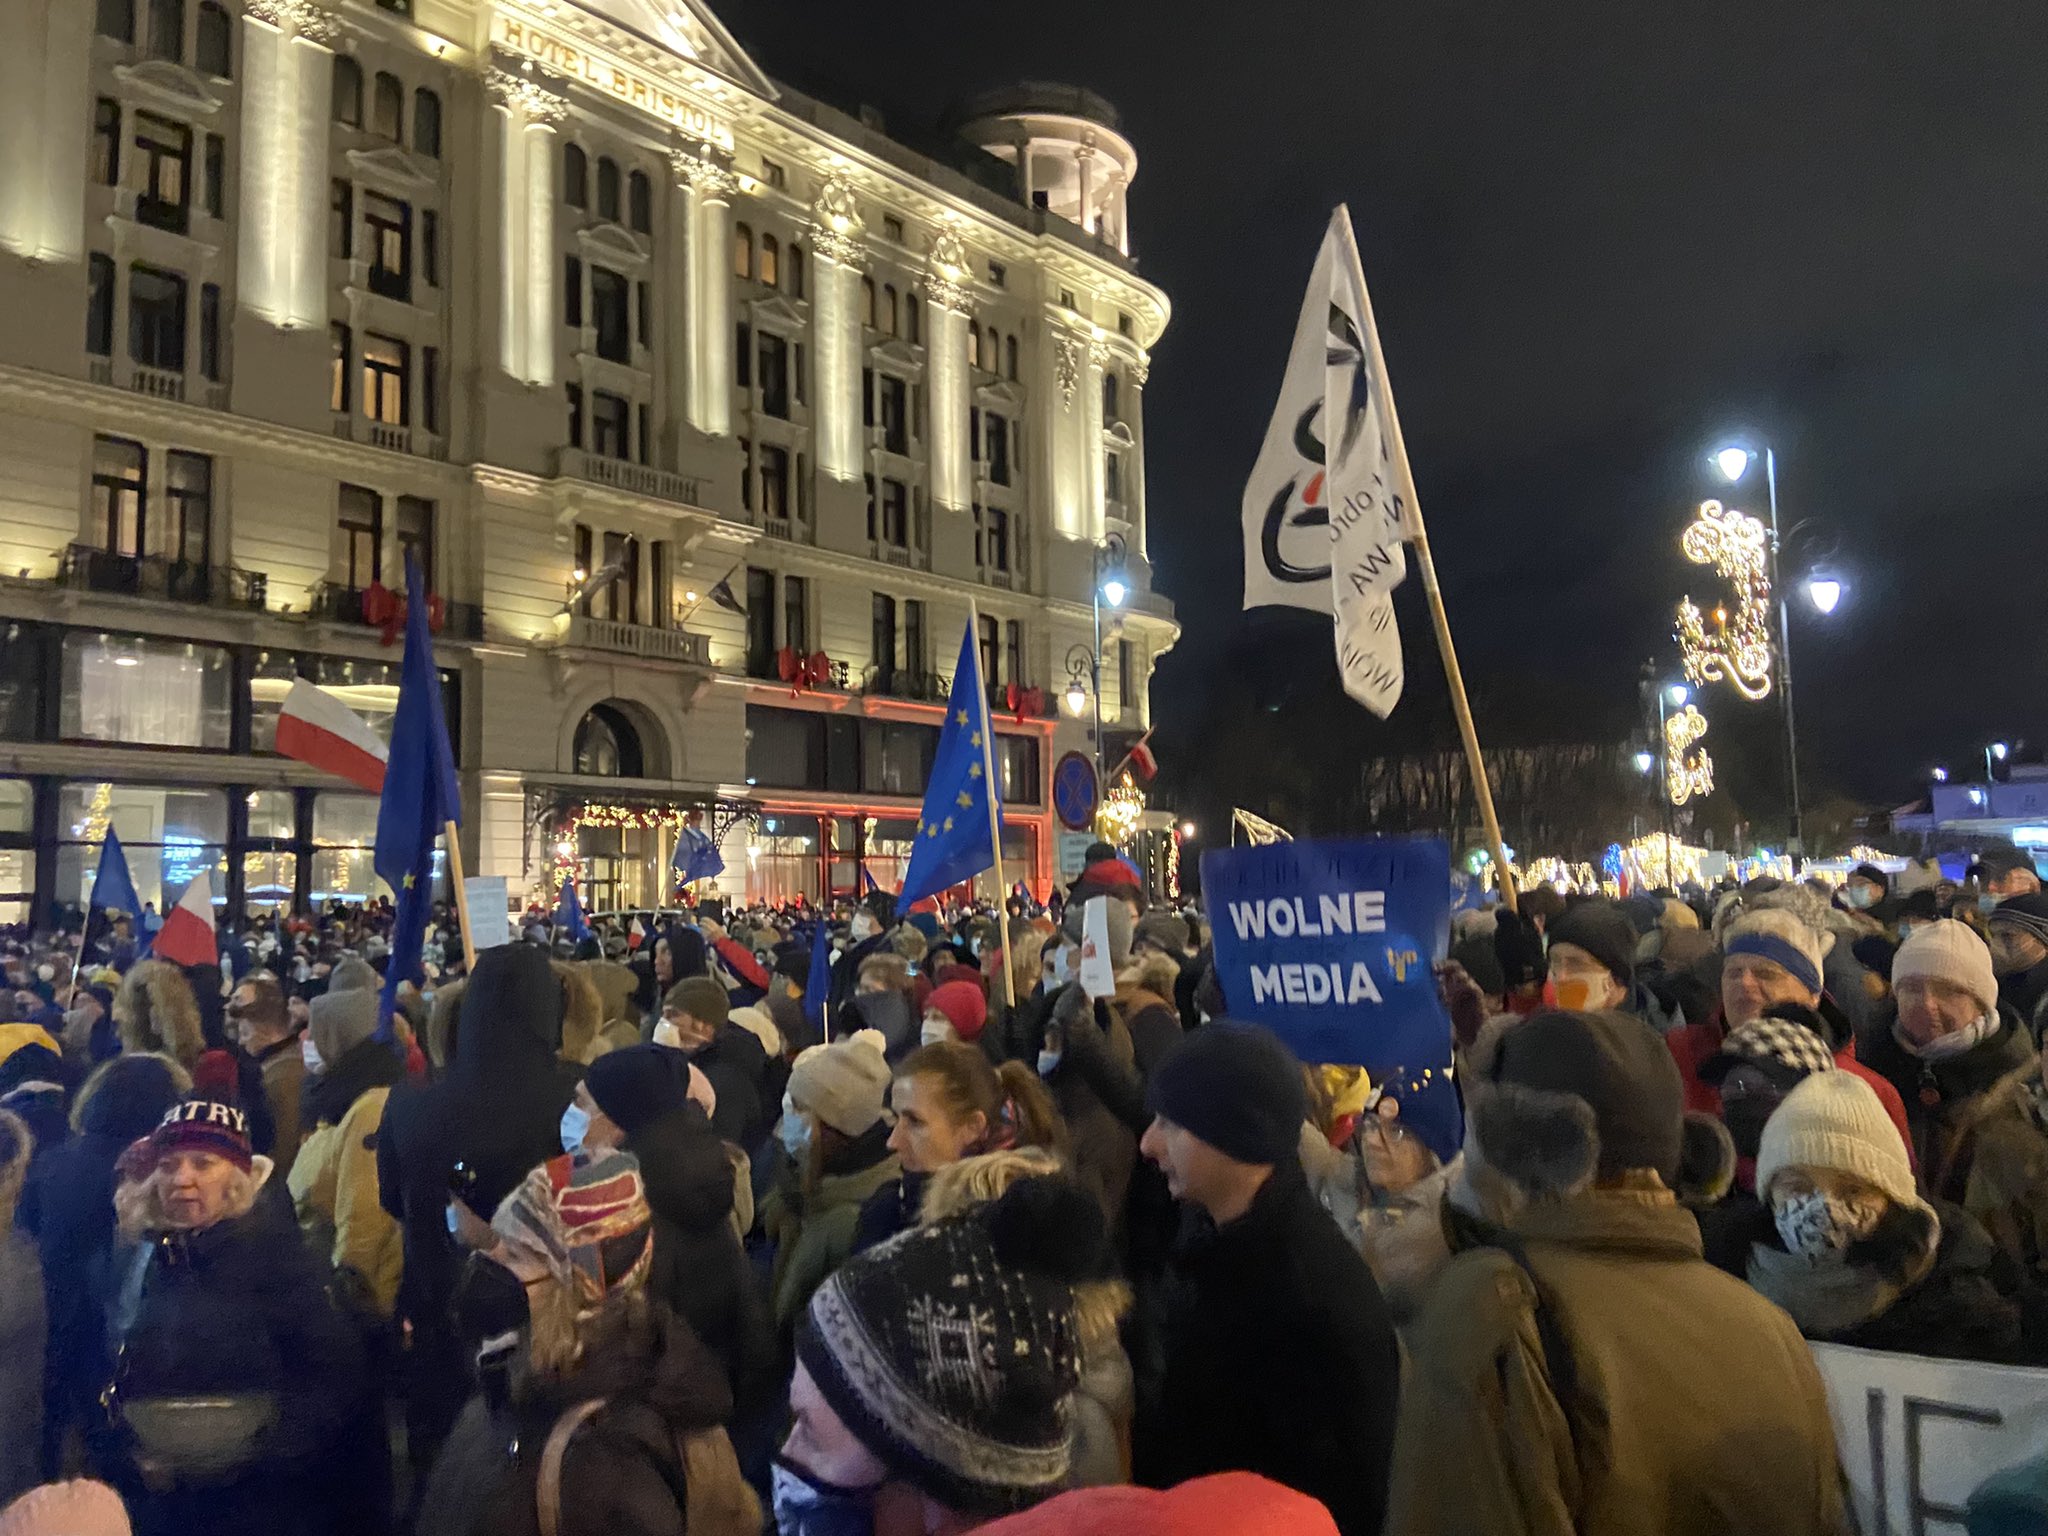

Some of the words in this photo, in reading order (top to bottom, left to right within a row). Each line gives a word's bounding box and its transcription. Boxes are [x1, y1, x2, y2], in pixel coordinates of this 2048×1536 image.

[504, 18, 598, 81] HOTEL
[611, 68, 723, 140] BRISTOL
[1228, 891, 1386, 940] WOLNE
[1250, 962, 1383, 1005] MEDIA
